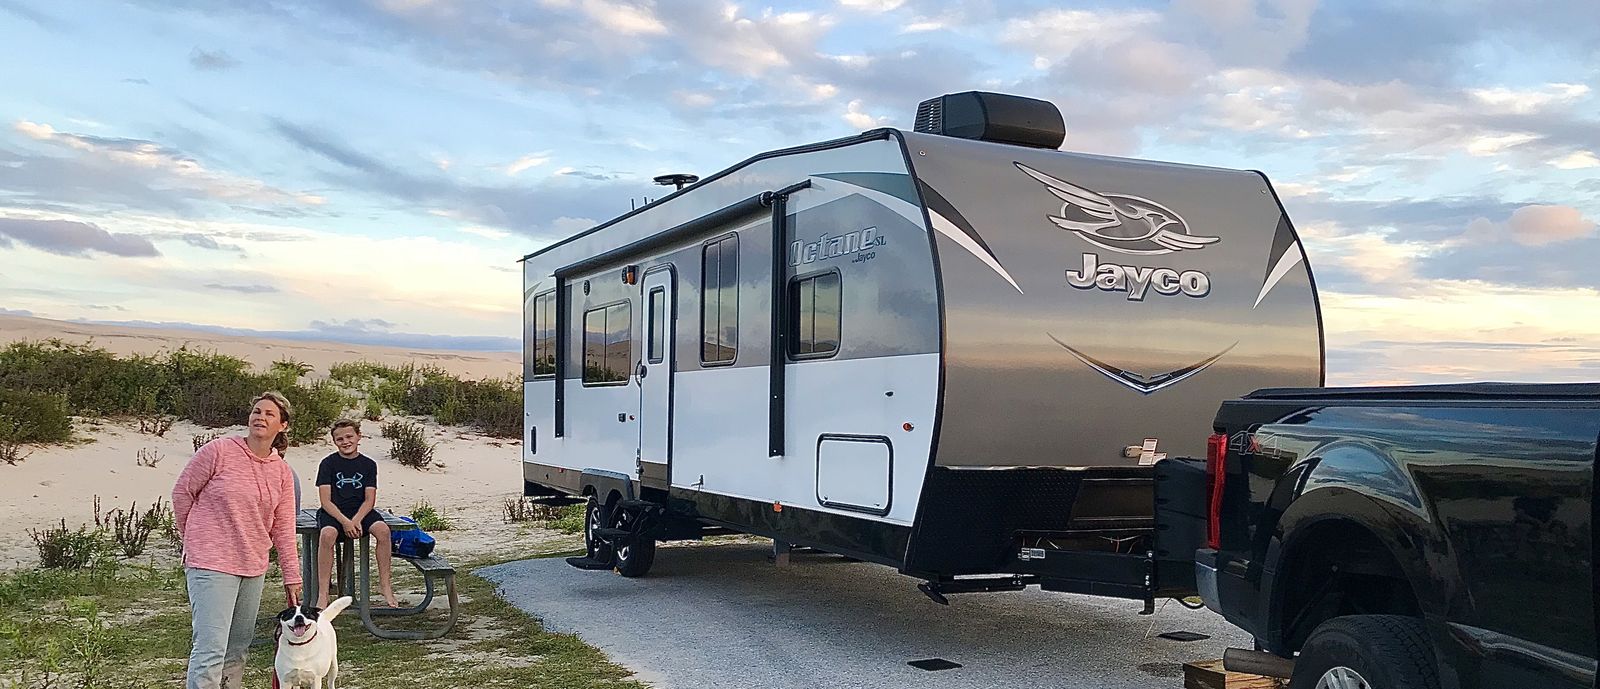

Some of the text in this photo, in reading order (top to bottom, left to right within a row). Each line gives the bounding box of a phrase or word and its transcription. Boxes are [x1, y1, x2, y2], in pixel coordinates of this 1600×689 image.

[789, 226, 887, 267] Octane SL
[1065, 252, 1211, 302] Jayco
